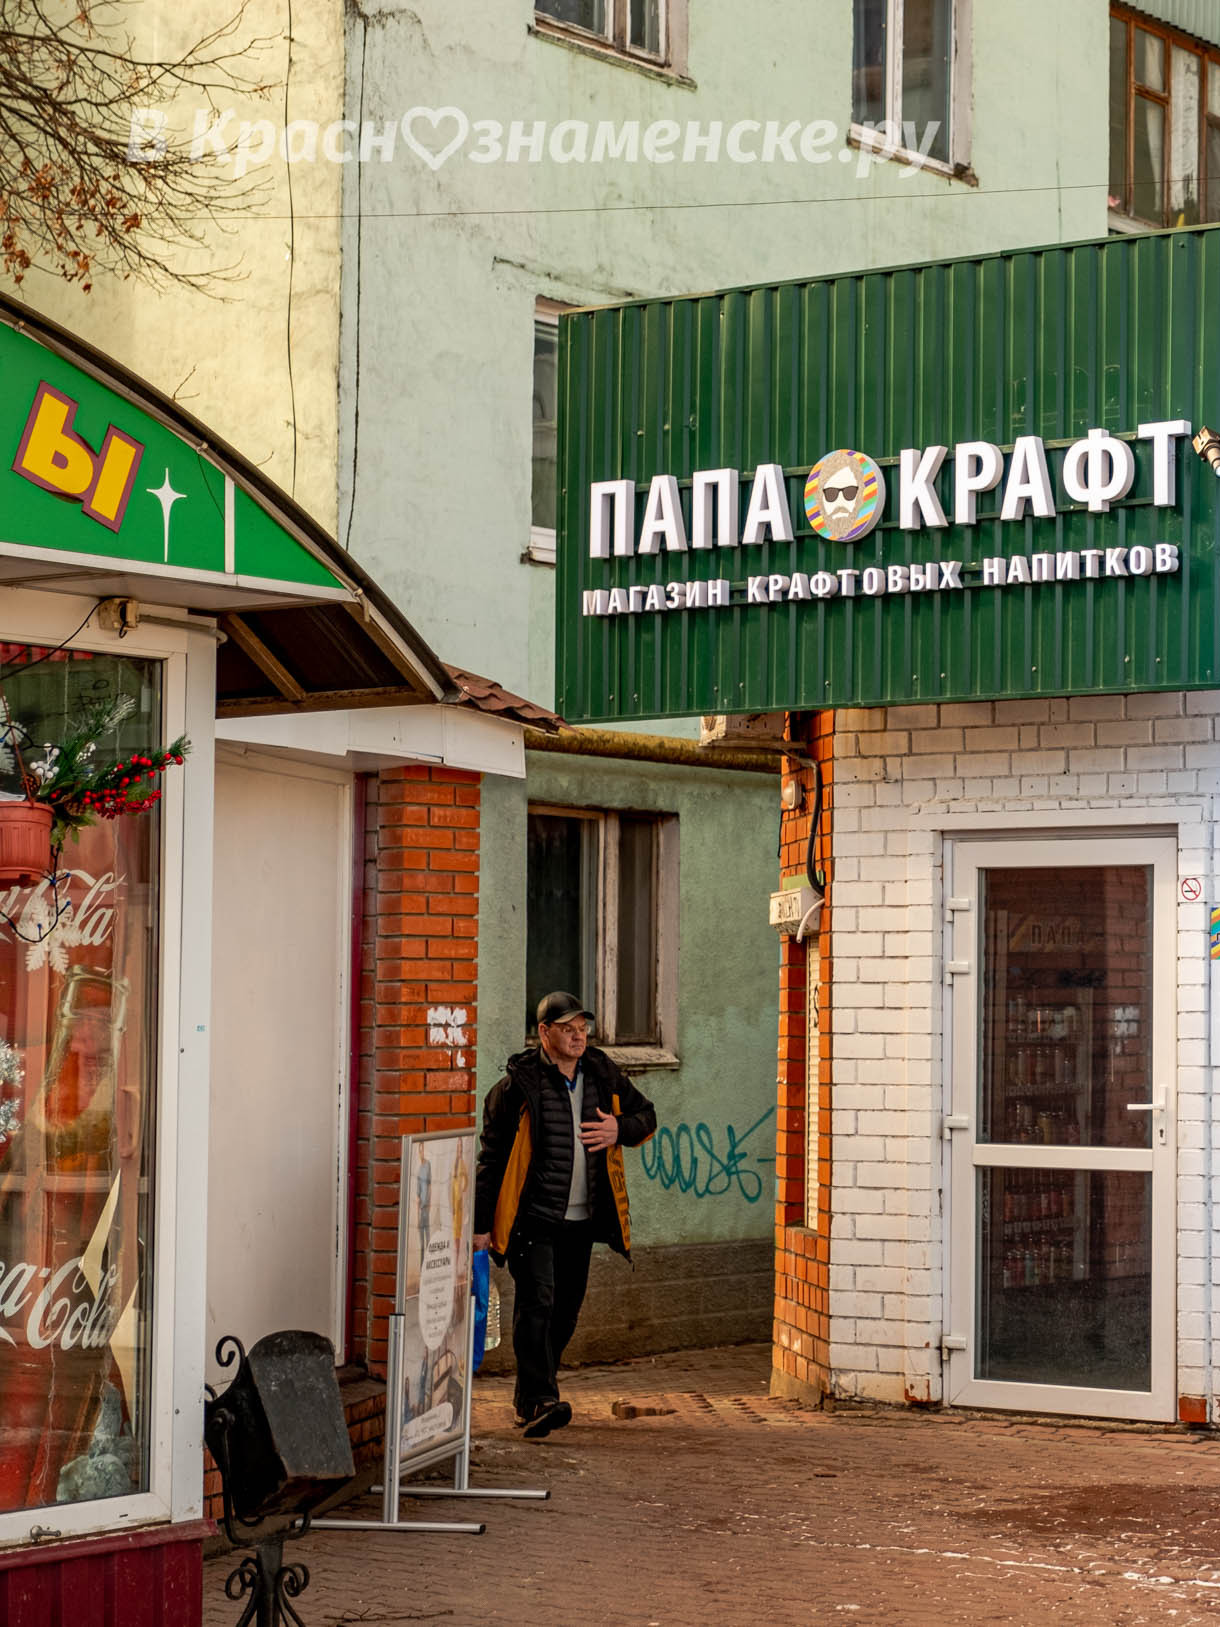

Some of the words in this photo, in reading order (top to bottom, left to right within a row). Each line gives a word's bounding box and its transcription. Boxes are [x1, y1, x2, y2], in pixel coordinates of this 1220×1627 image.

[589, 463, 795, 559] ПАПА
[898, 419, 1193, 531] КРАФТ
[582, 578, 730, 617] МАГАЗИН
[745, 560, 964, 604] КРАФТОВЫХ
[982, 543, 1179, 587] НАПИТКОВ
[0, 1256, 118, 1351] a-Cola
